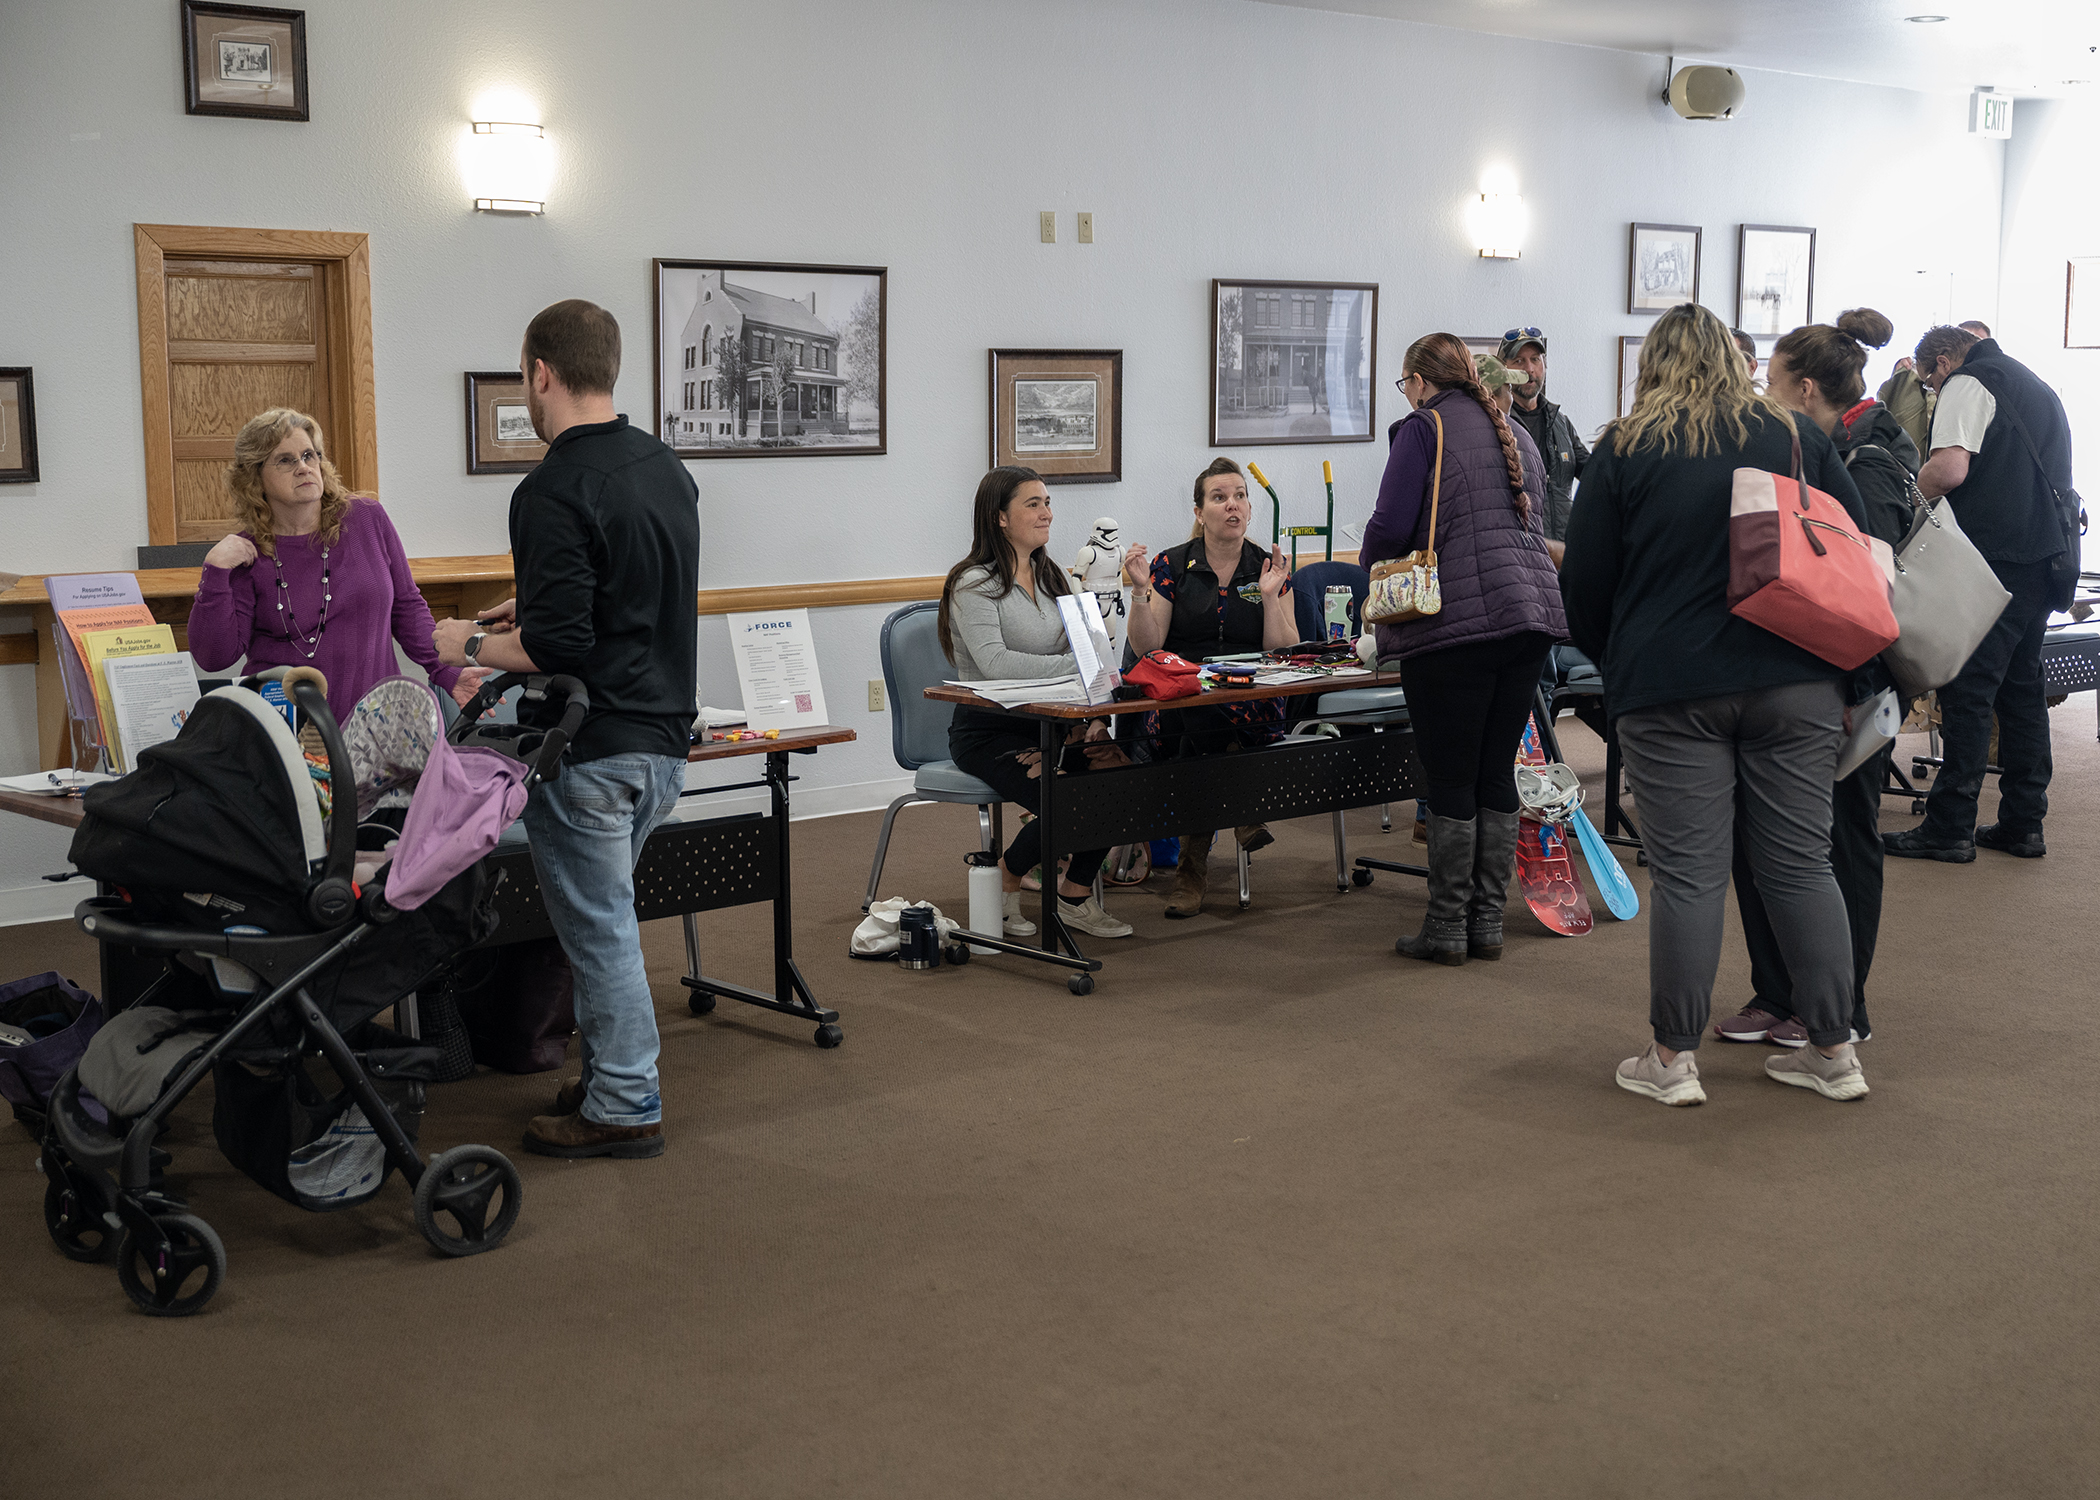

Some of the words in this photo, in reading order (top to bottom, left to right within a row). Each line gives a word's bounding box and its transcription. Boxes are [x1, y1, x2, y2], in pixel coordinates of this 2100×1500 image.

[1985, 99, 2007, 131] EXIT
[1291, 527, 1317, 535] CONTROL
[755, 621, 792, 630] FORCE
